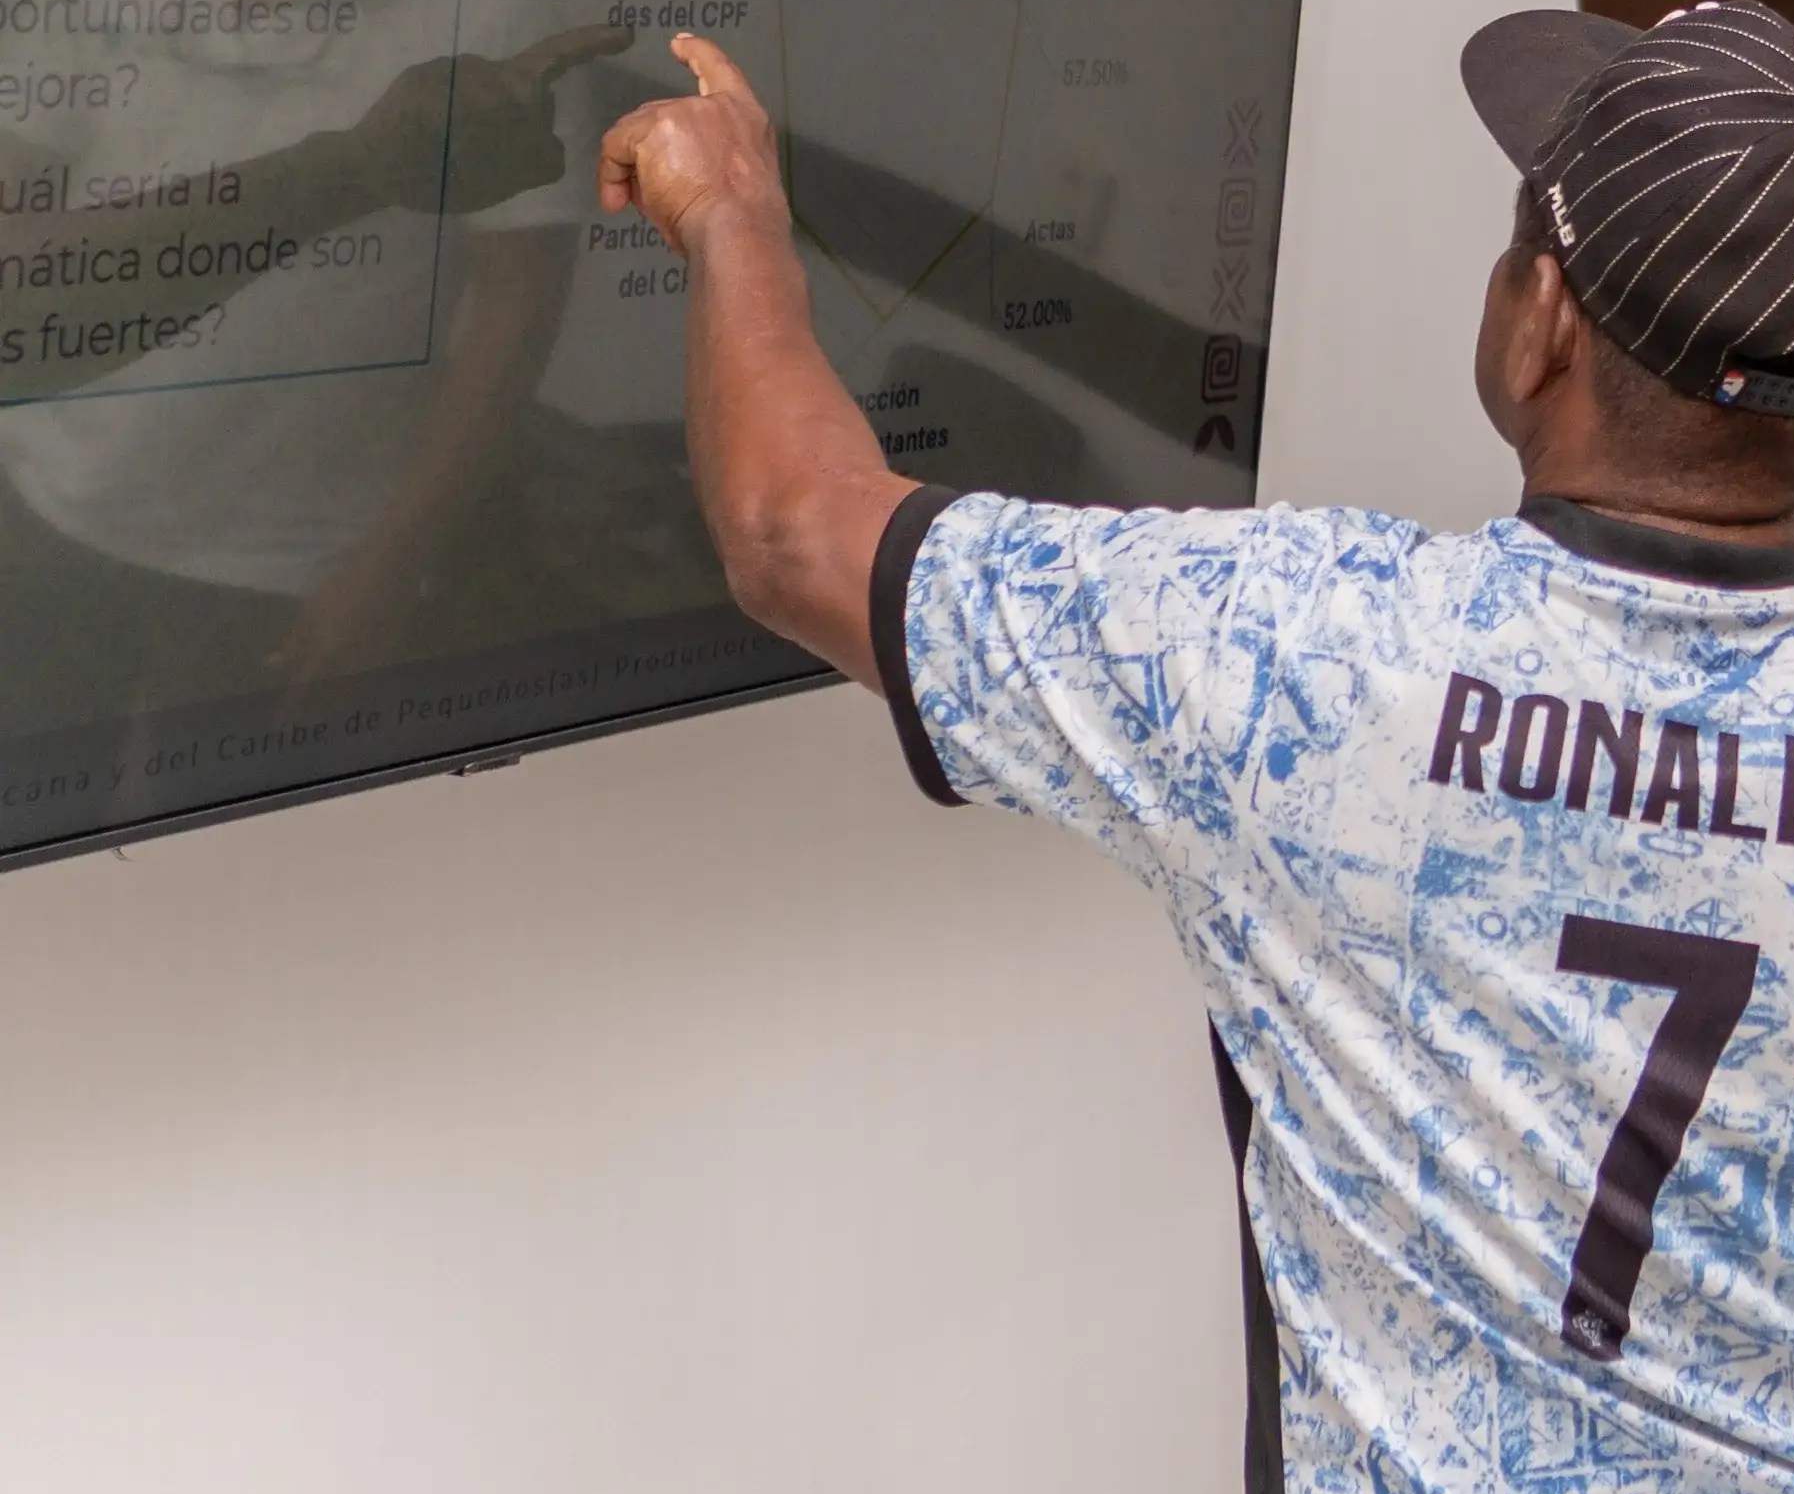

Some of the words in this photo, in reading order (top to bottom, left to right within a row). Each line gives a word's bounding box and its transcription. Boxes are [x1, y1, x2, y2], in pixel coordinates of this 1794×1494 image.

[608, 0, 652, 29] des
[658, 0, 695, 29] del
[701, 1, 749, 29] CPF
[84, 161, 191, 210] sería
[207, 161, 242, 207] la
[1024, 219, 1076, 244] Actas
[1547, 181, 1575, 247] MLB
[157, 227, 299, 280] donde
[311, 231, 382, 269] son
[618, 268, 656, 299] del
[38, 301, 226, 362] fuertes?
[1004, 298, 1073, 331] 52.00%
[107, 761, 127, 791] y
[144, 740, 199, 778] del
[217, 719, 330, 763] Caribe
[343, 708, 382, 736] de
[1555, 913, 1761, 1362] 7
